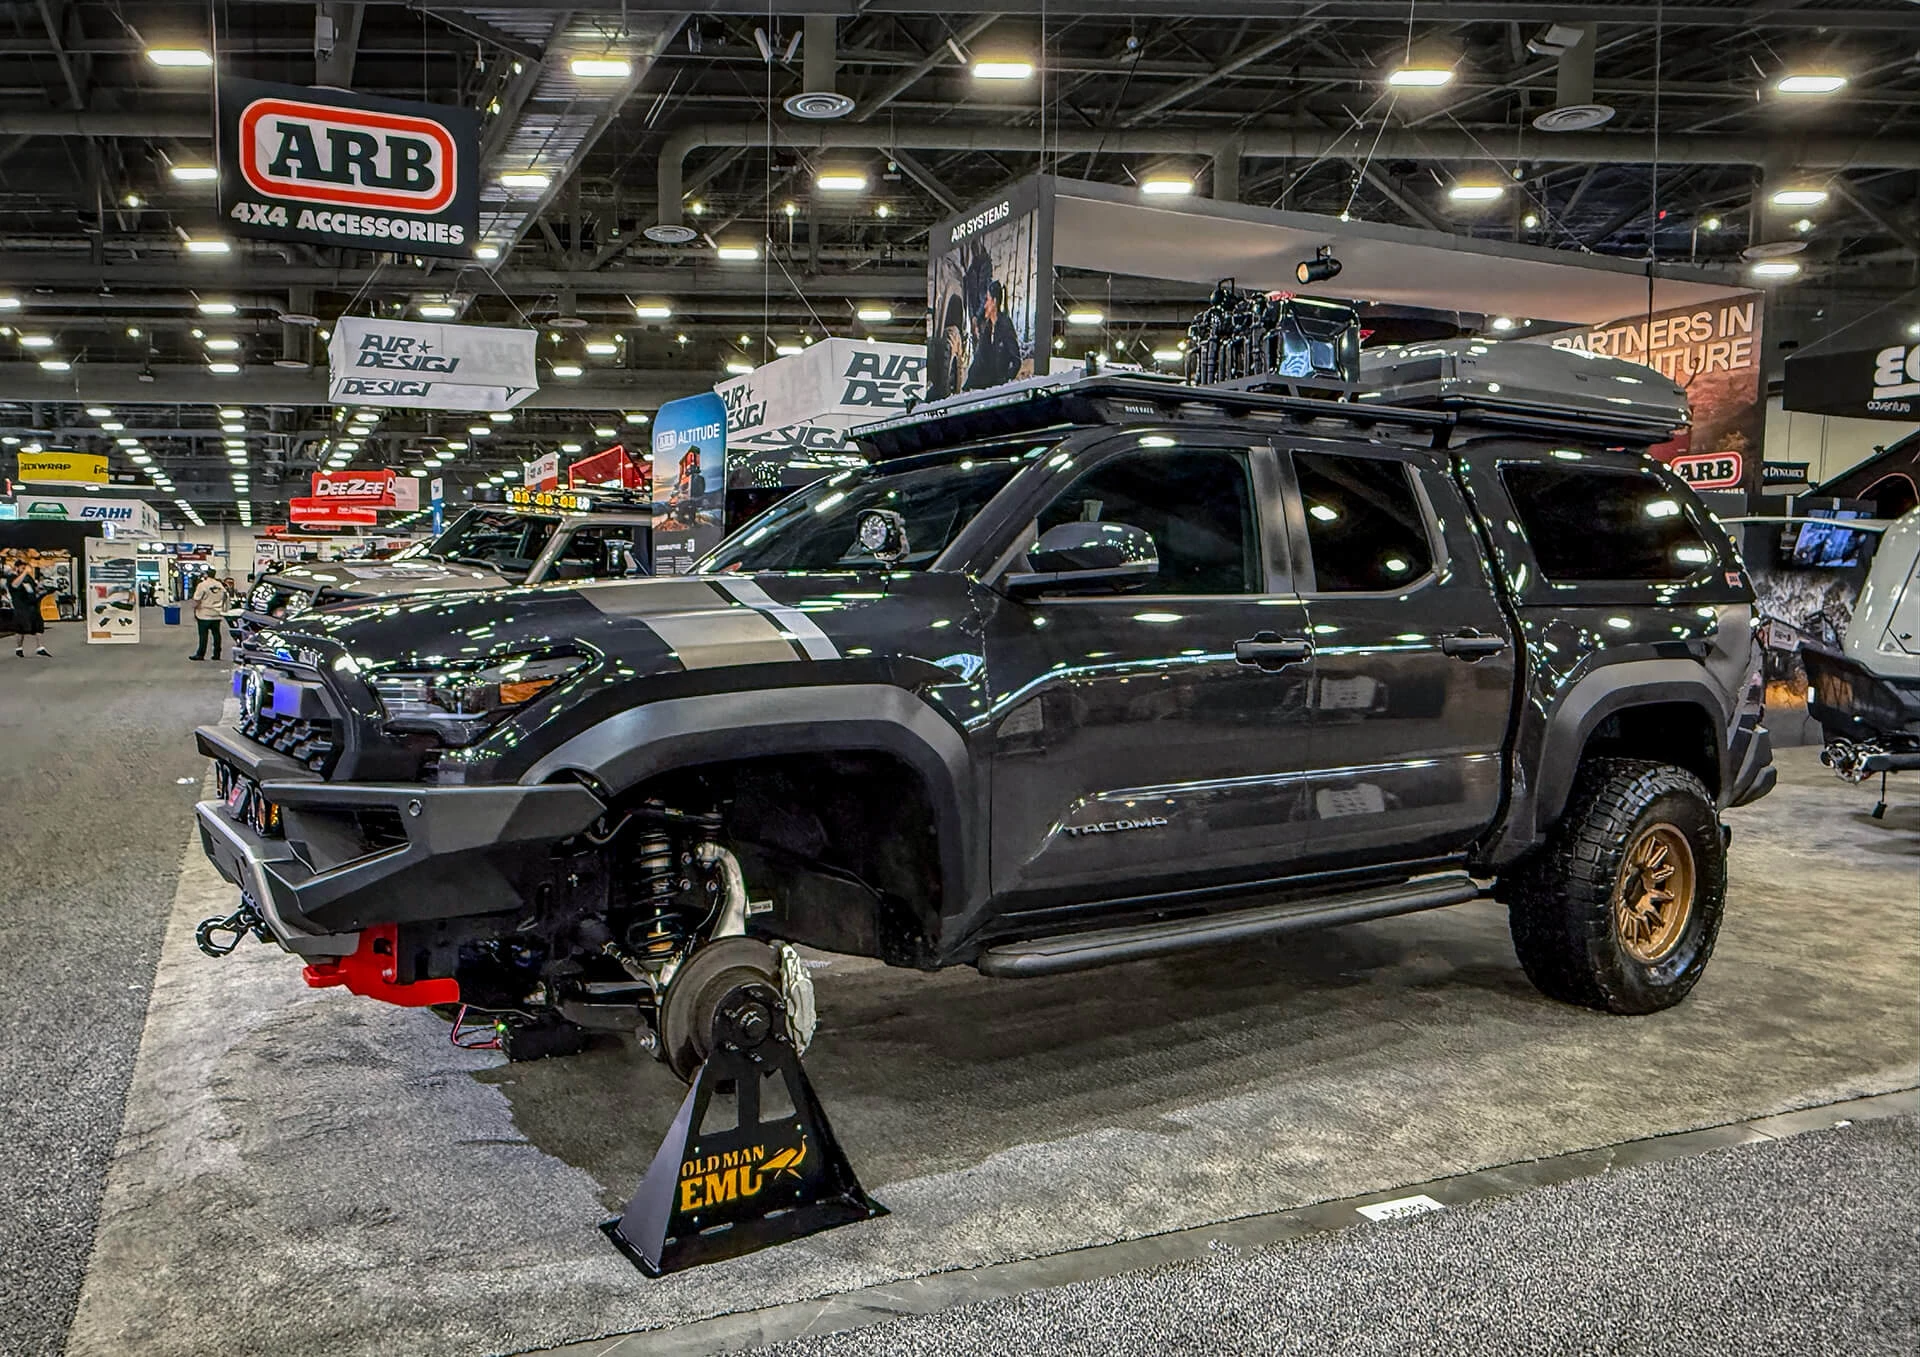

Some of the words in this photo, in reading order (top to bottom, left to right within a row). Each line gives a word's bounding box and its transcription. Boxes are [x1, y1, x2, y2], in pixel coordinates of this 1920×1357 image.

[268, 121, 436, 192] ARB
[231, 202, 288, 227] 4X4
[296, 209, 465, 245] ACCESSORIES
[951, 222, 966, 243] AIR
[966, 200, 1010, 235] SYSTEMS
[360, 333, 416, 353] AIR
[1551, 312, 1713, 357] RTNERS
[1719, 303, 1754, 338] IN
[356, 351, 460, 374] DESIGN
[844, 351, 926, 381] AIR
[678, 423, 720, 444] ALTITUDE
[1680, 460, 1733, 481] ARB
[80, 506, 132, 519] GAHH
[1064, 816, 1168, 836] TACOMA
[682, 1155, 720, 1177] OLD
[723, 1145, 764, 1168] MAN
[680, 1166, 763, 1212] EMU
